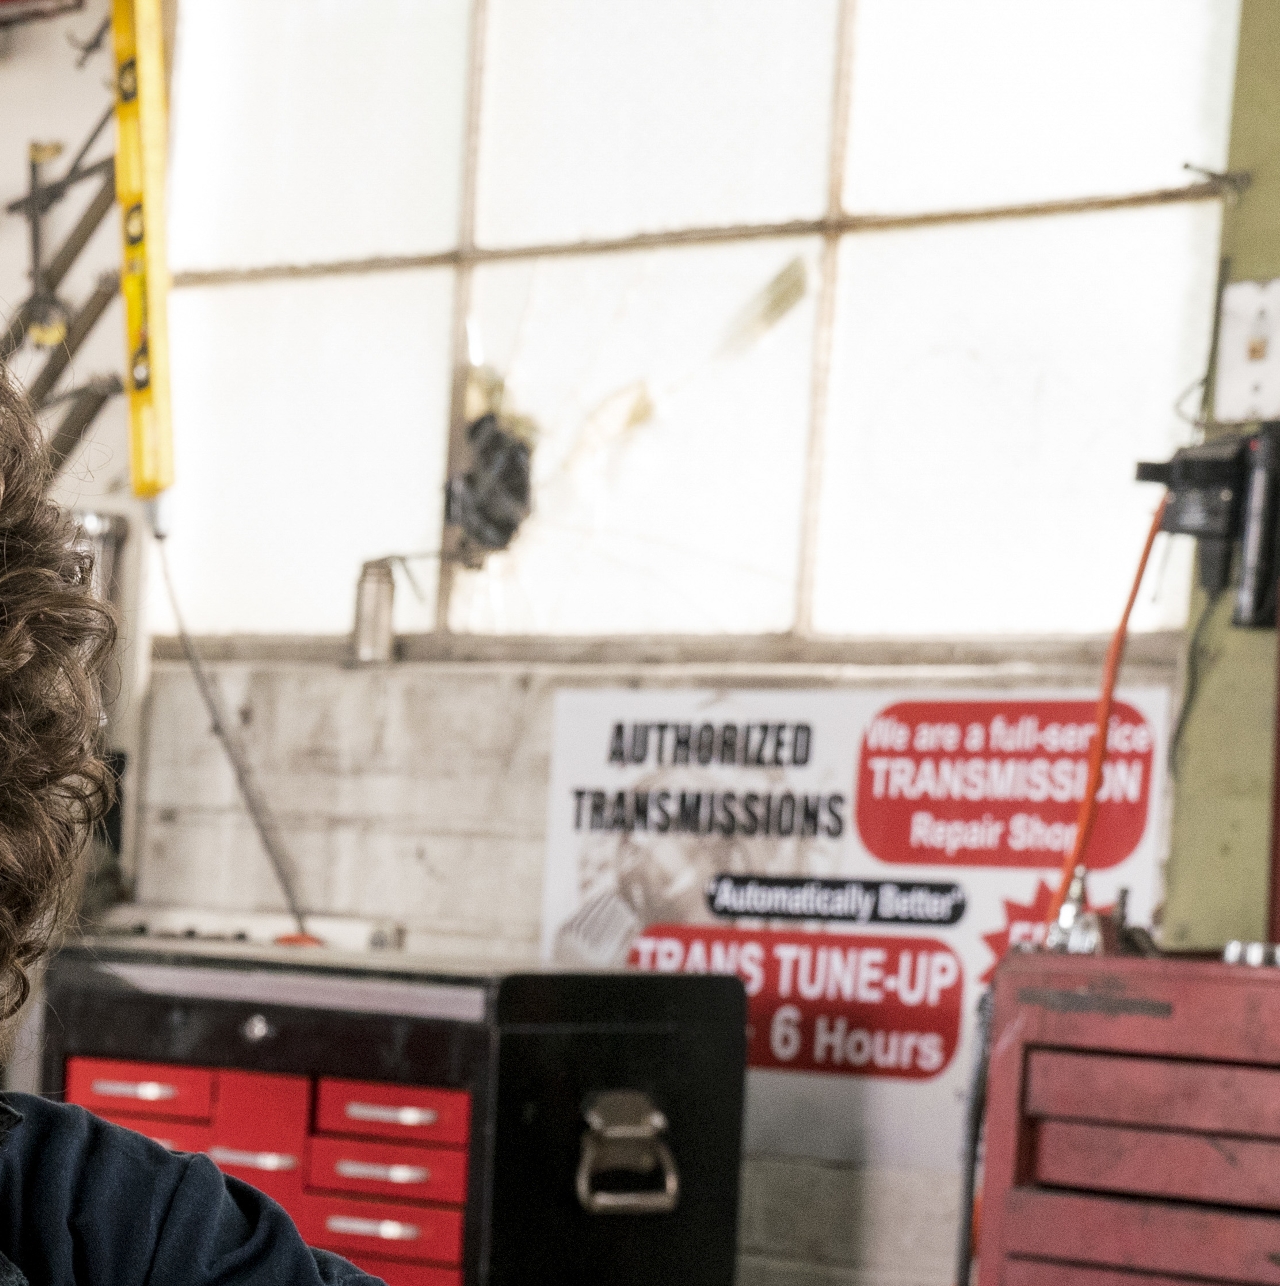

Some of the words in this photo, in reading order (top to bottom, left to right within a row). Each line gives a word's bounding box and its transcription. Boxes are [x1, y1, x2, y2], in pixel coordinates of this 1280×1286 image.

[608, 722, 812, 767] AUTHORIZED
[867, 716, 911, 751] We
[913, 722, 961, 752] are
[964, 722, 986, 752] a
[989, 714, 1151, 753] full-serice
[574, 788, 844, 838] TRANSMISSIONS
[909, 811, 1005, 857] Repair
[774, 944, 959, 1006] TUNE-UP
[769, 1004, 802, 1062] 6
[813, 1015, 943, 1071] Hours
